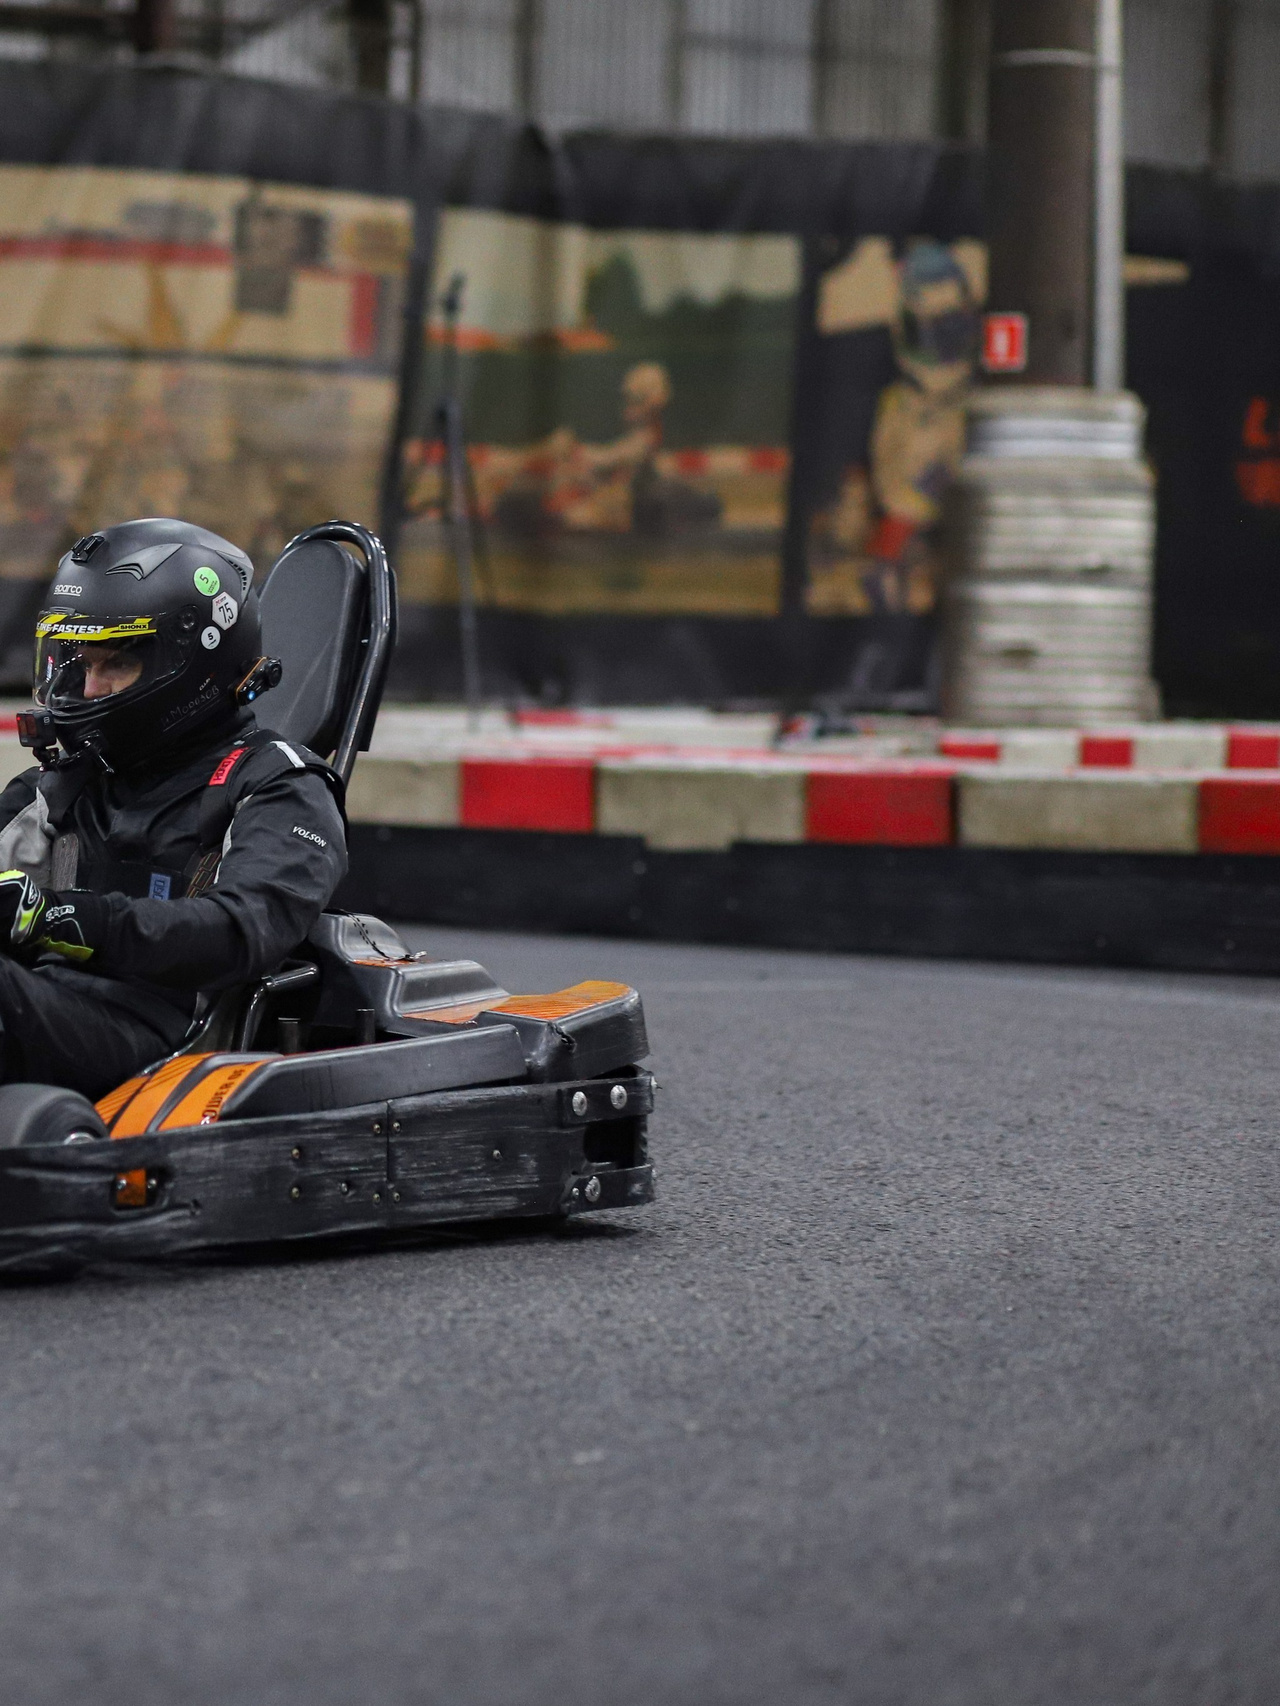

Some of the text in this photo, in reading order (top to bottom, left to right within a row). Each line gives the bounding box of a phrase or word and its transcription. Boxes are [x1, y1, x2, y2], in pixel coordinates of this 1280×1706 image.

[199, 574, 209, 584] 5
[54, 584, 82, 594] sparco
[52, 623, 104, 634] FASTEST
[207, 632, 214, 641] 5
[292, 826, 327, 847] VOLSON
